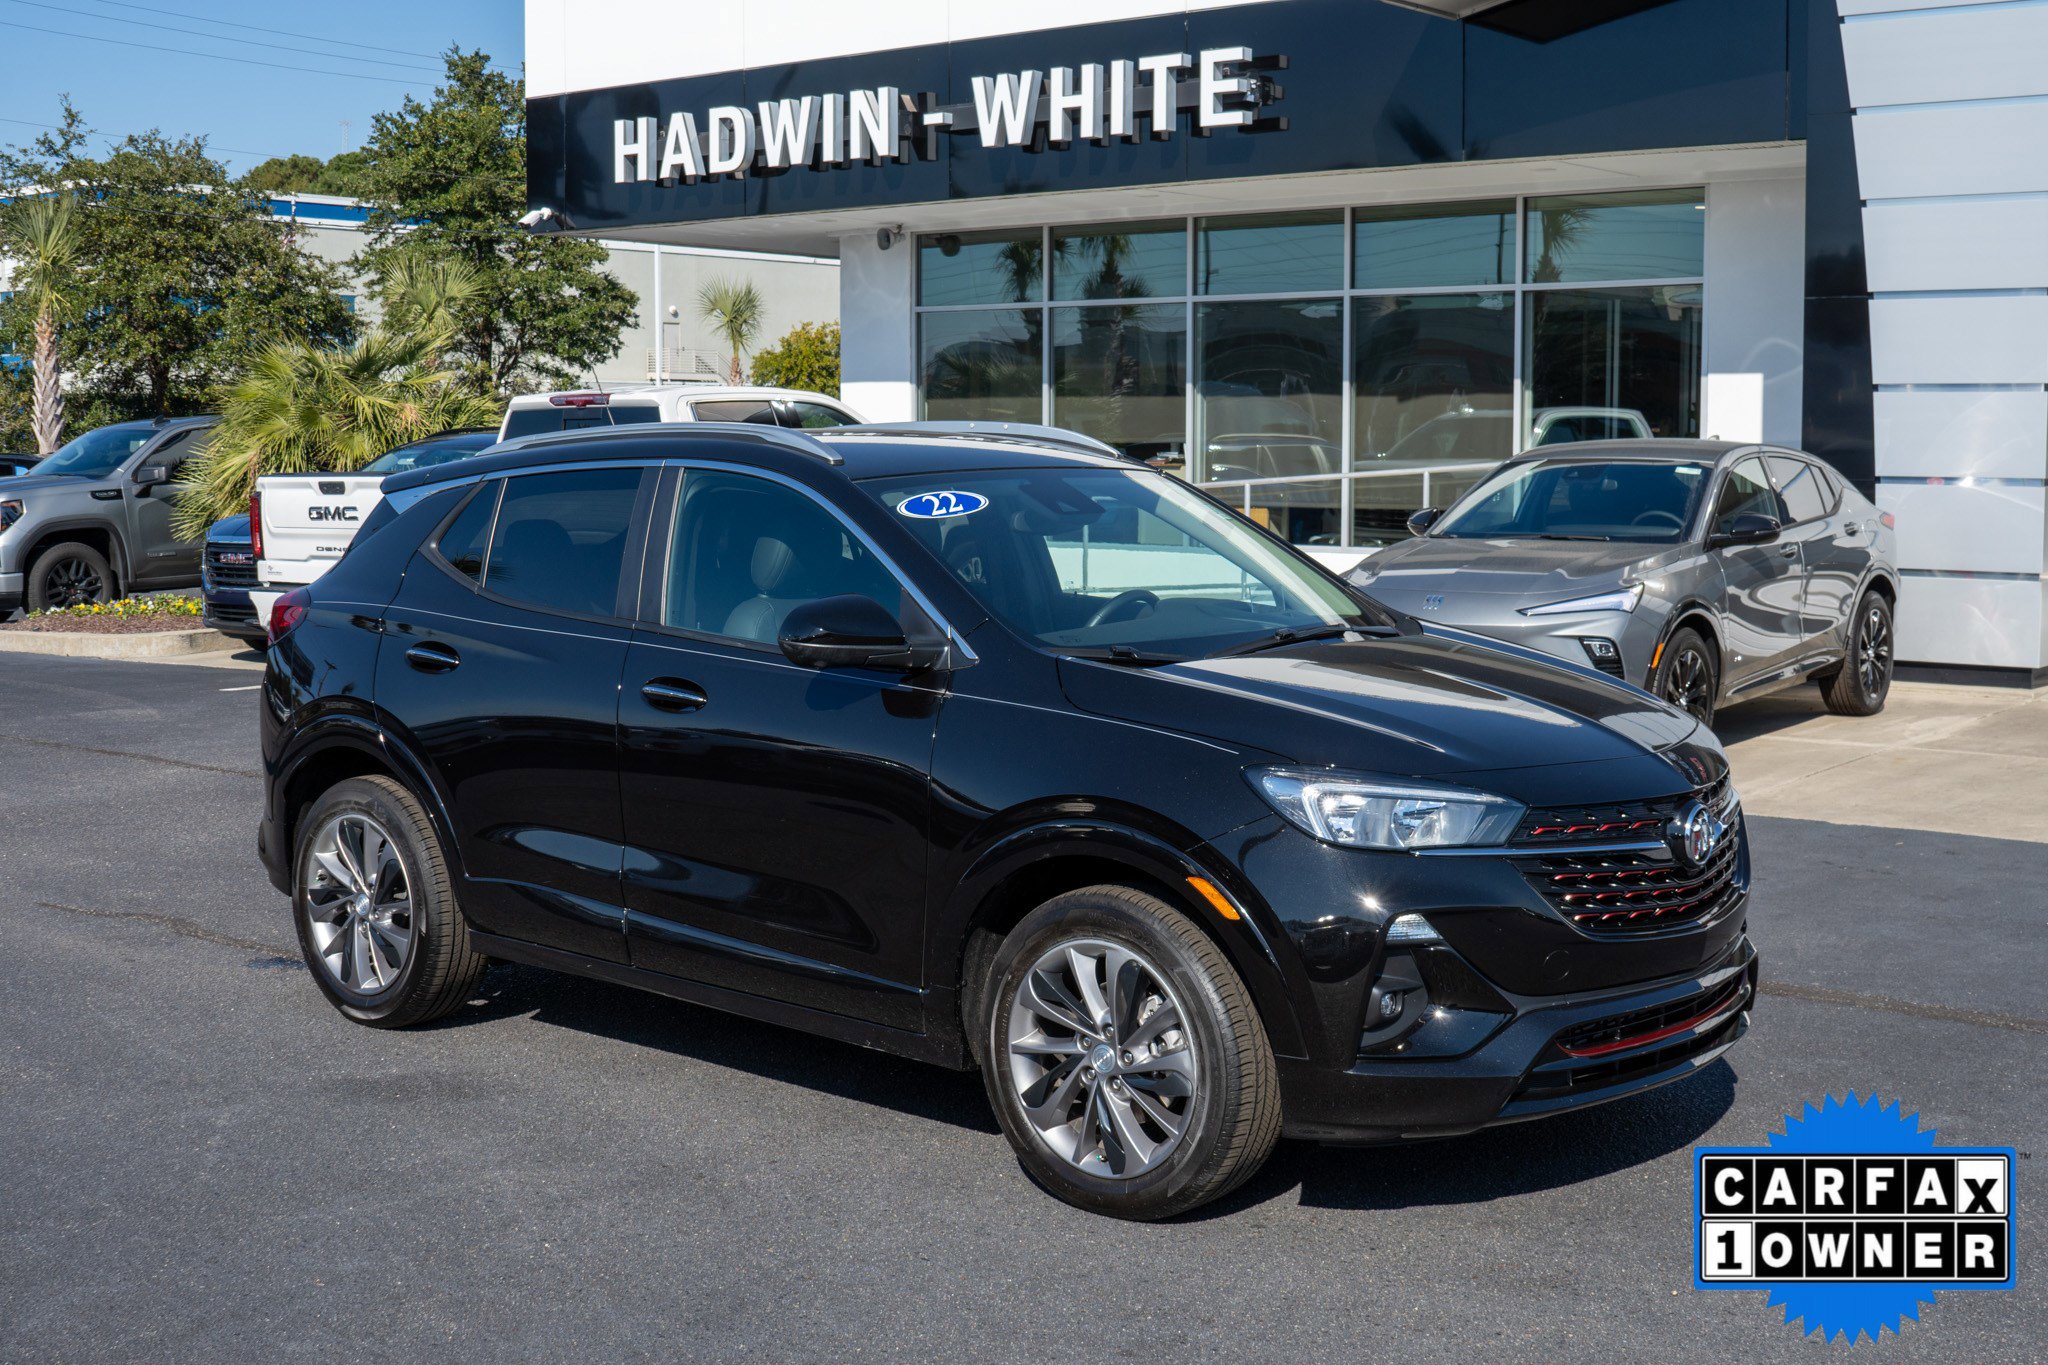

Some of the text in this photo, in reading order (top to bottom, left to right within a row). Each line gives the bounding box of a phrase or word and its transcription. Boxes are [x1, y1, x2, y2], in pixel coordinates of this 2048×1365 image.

[613, 86, 899, 184] HADWIN
[971, 46, 1253, 148] WHITE
[308, 506, 359, 522] GMC
[922, 492, 964, 516] 22
[219, 553, 253, 564] GMC
